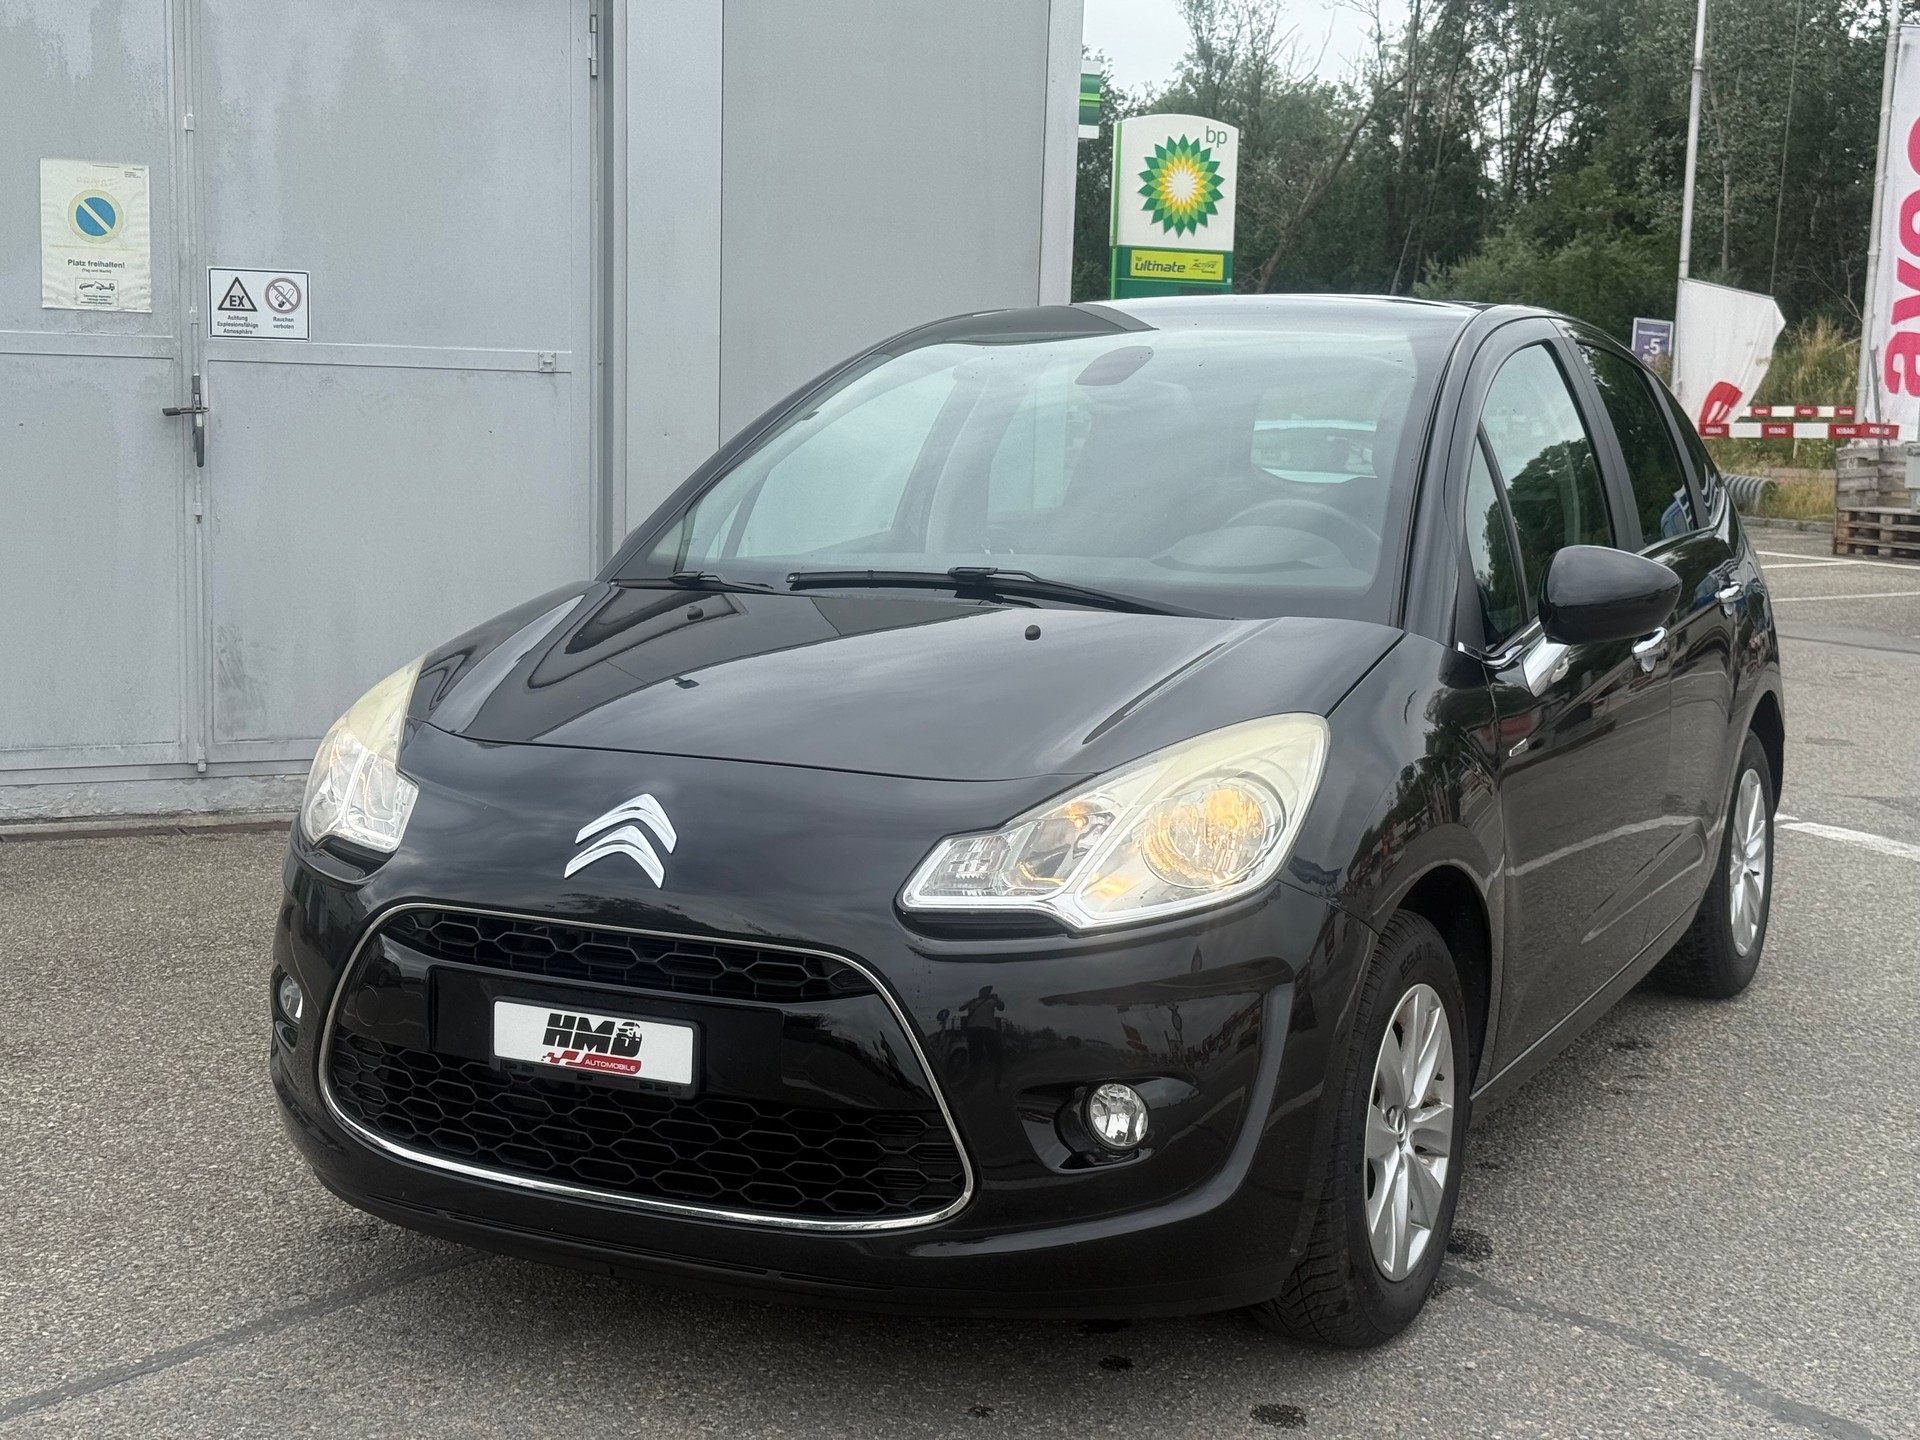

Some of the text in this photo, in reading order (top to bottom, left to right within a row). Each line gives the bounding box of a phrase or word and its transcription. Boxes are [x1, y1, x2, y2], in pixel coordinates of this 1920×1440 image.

[1206, 125, 1228, 148] bp
[67, 259, 125, 268] Platz freihalten!
[1135, 260, 1185, 273] ultimate
[229, 295, 245, 307] EX
[227, 314, 248, 322] Achtung
[542, 1013, 643, 1058] HMD
[584, 1059, 636, 1072] AUTOMOBILE
